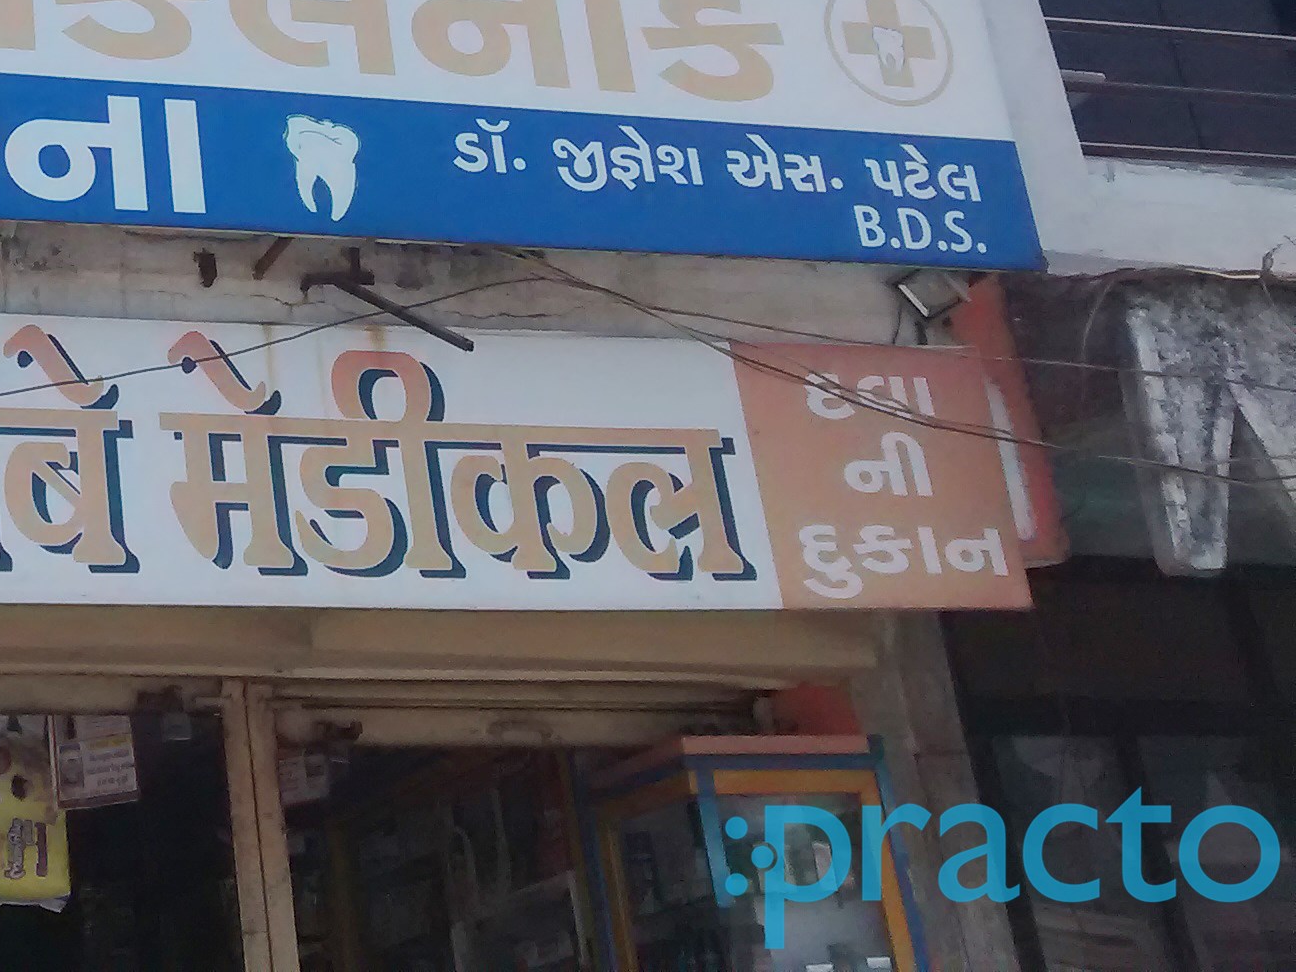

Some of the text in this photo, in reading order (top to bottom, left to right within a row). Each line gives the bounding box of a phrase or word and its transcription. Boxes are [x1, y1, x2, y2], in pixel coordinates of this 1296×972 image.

[725, 134, 844, 193] એસ.
[864, 144, 982, 202] પટેલ
[854, 205, 988, 254] B.D.S.
[805, 373, 936, 420] દવા
[844, 431, 934, 497] ની
[799, 524, 1009, 599] દુકાન
